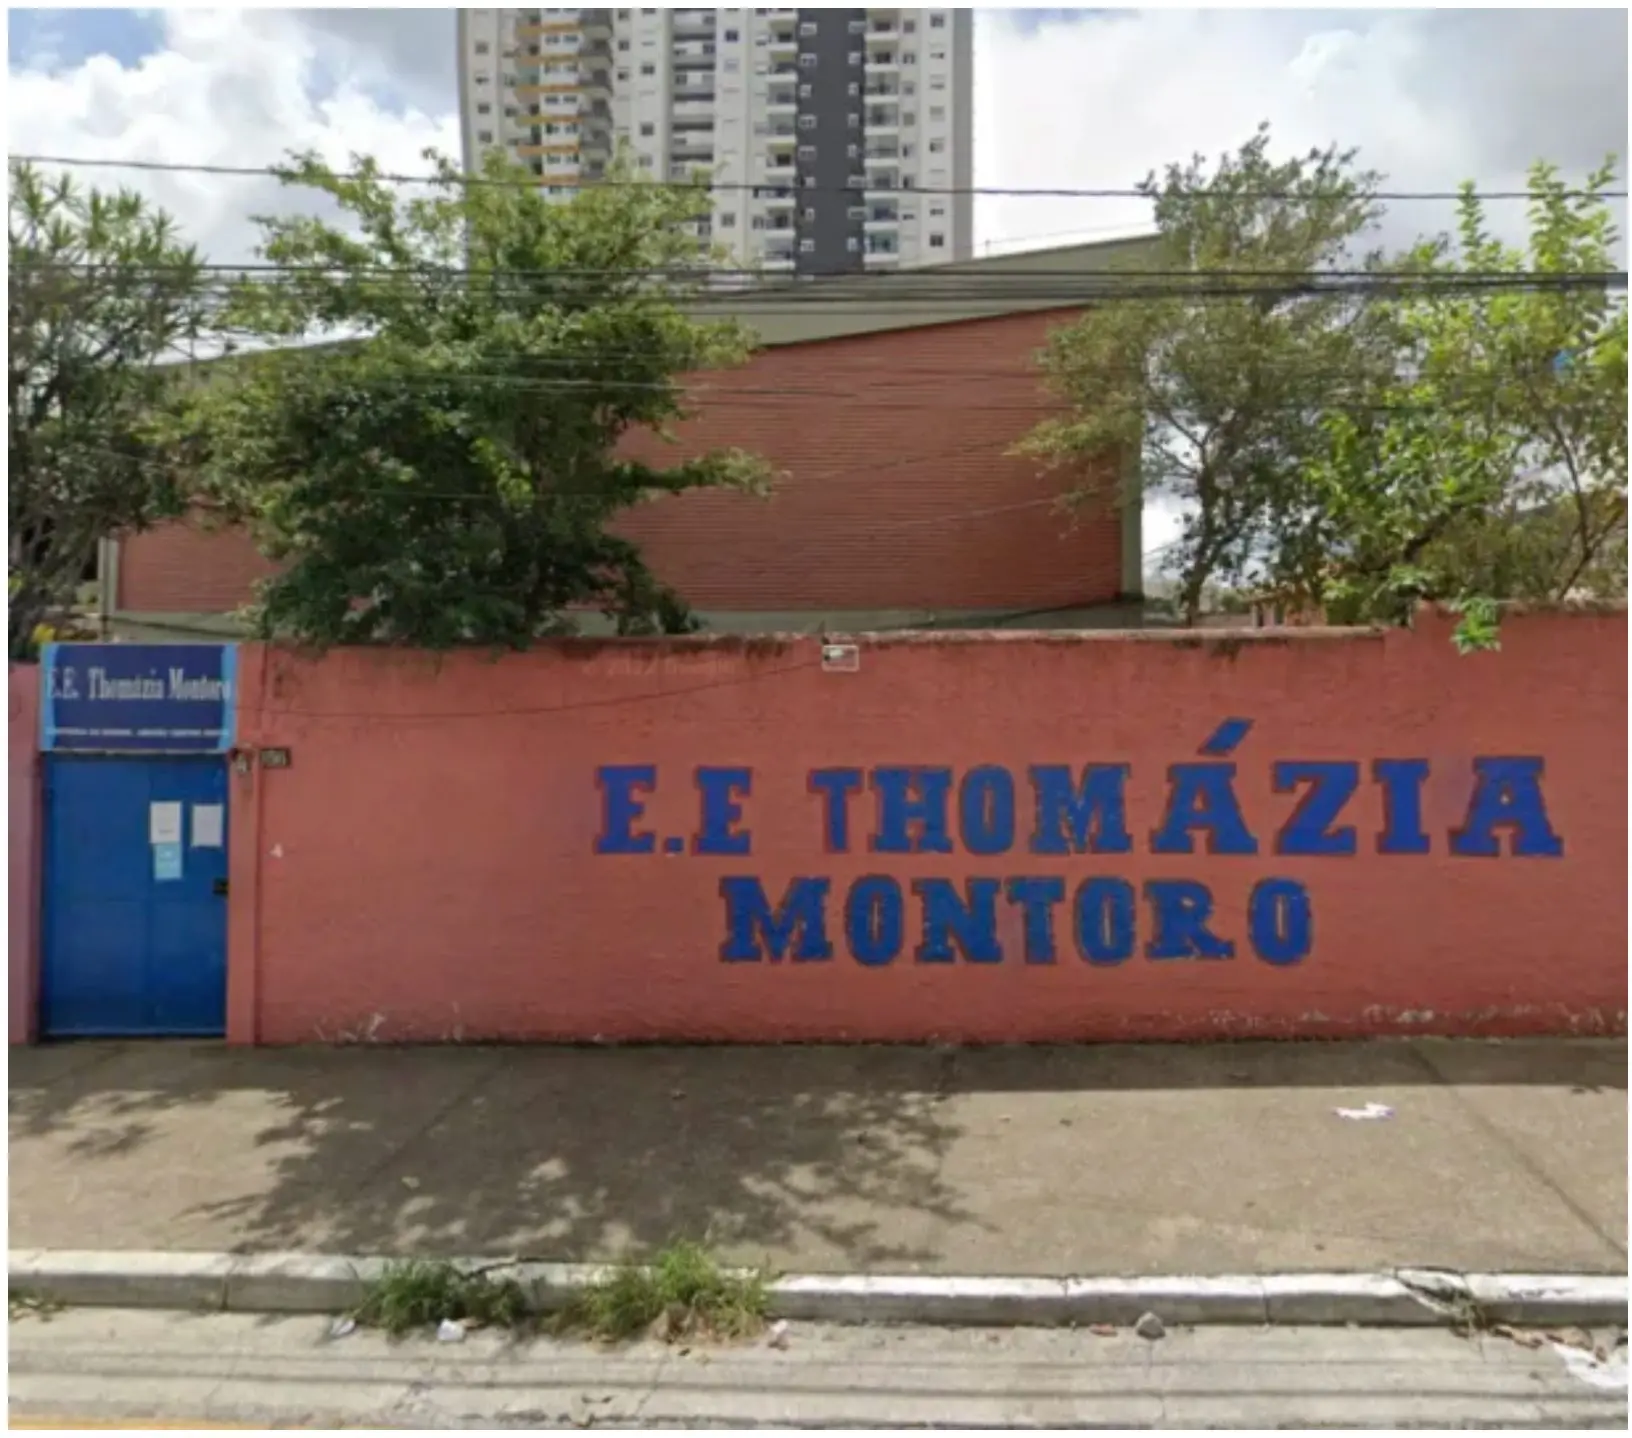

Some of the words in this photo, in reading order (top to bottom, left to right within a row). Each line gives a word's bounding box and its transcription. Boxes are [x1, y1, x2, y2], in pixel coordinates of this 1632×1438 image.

[596, 766, 752, 856] E.E
[809, 718, 1563, 857] THOMÁZIA
[721, 875, 1312, 966] MONTORO
